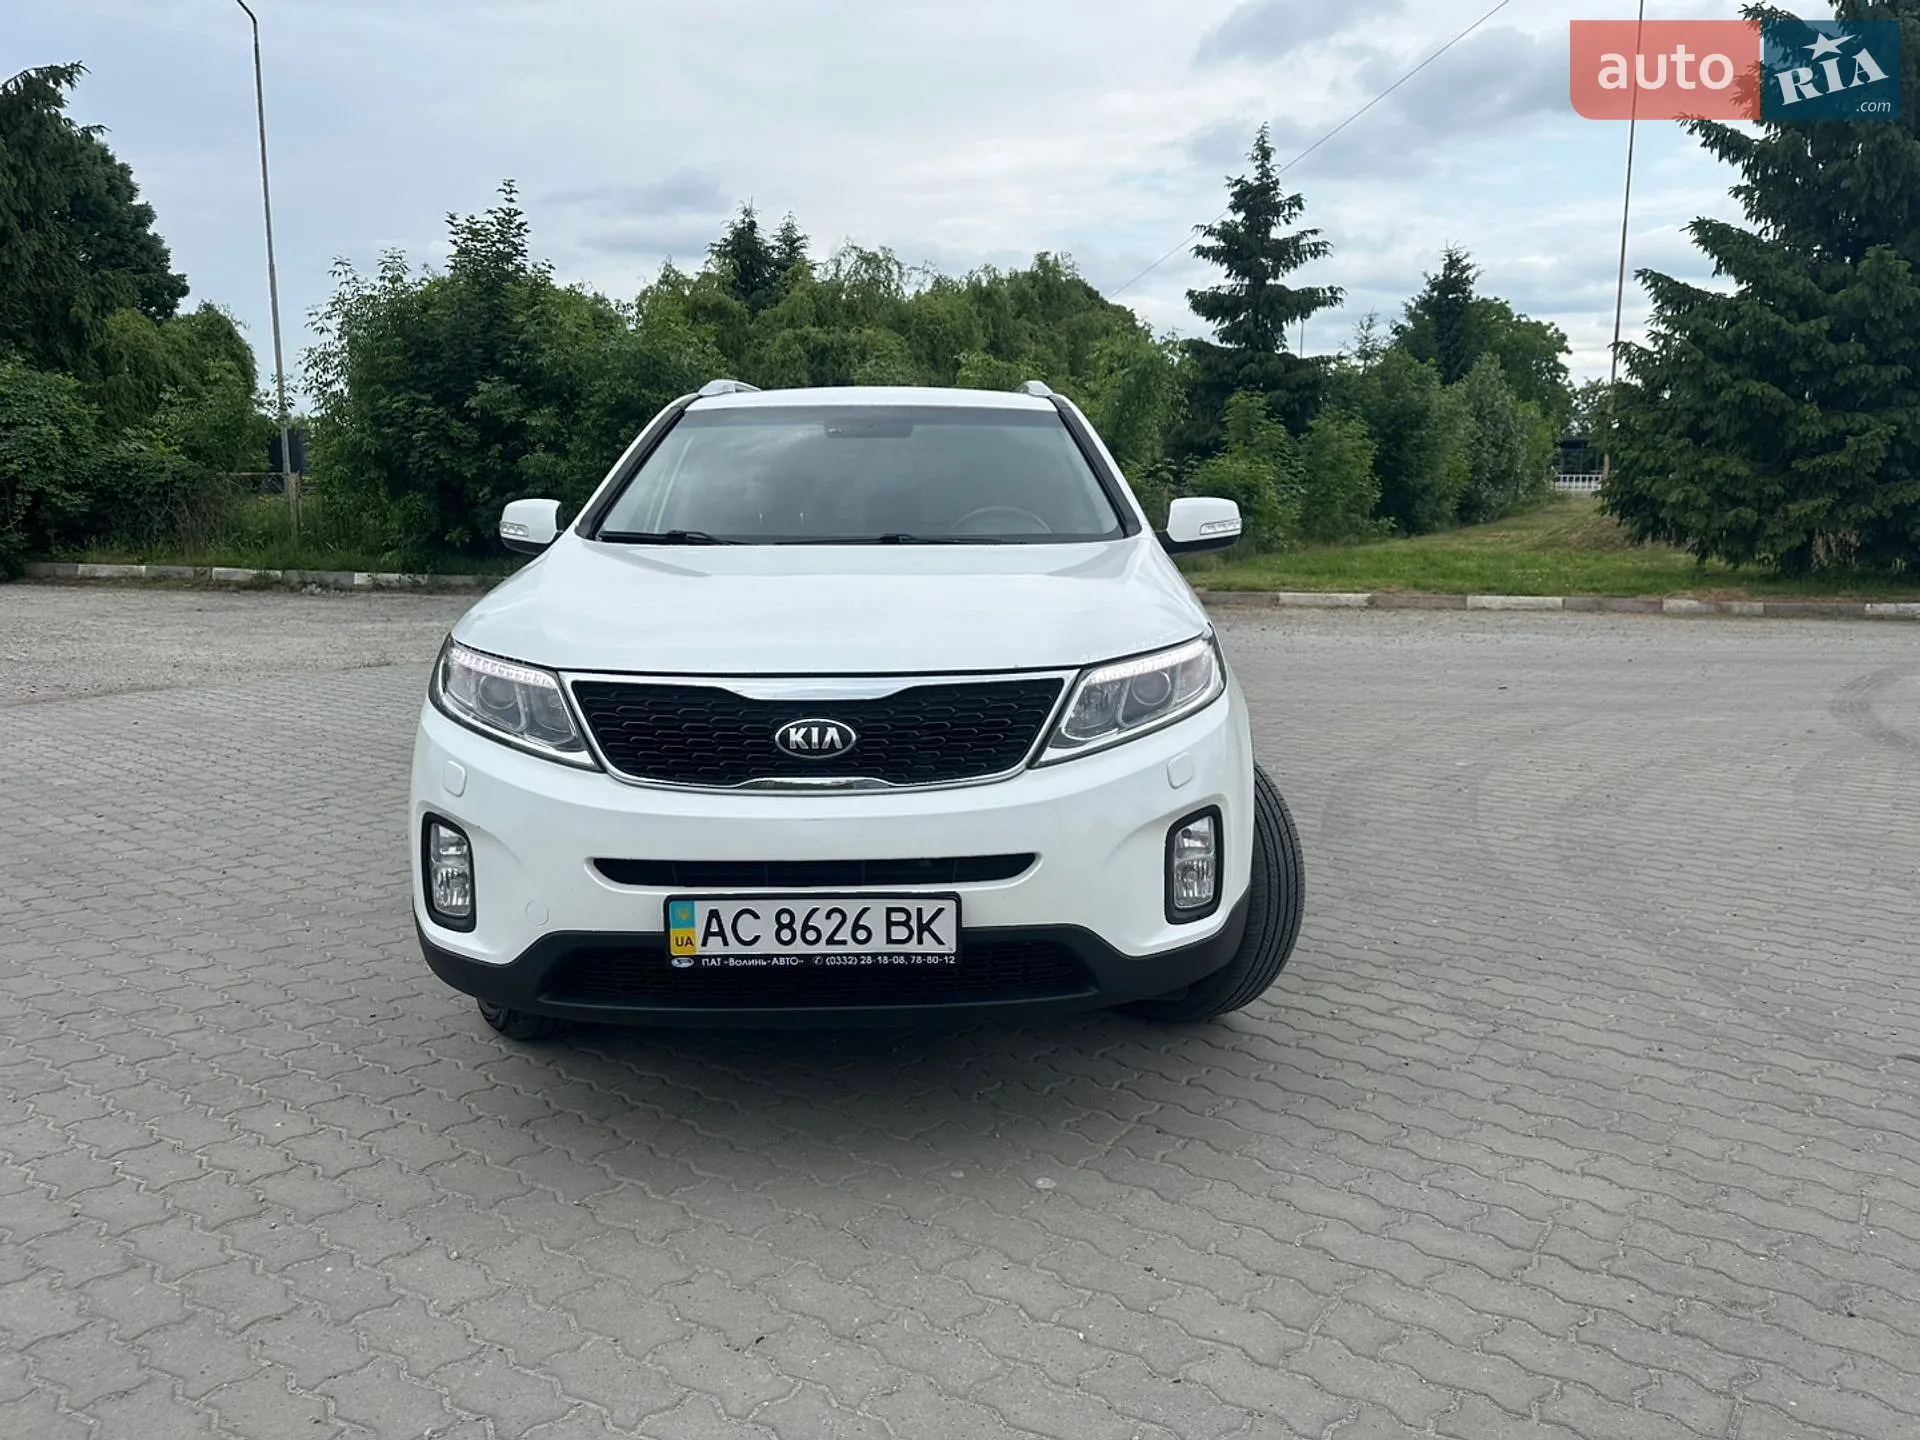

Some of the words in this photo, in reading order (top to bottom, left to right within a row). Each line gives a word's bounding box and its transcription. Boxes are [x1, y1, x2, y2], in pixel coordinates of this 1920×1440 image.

[788, 726, 843, 750] KIA
[701, 908, 761, 947] AC
[775, 907, 873, 946] 8626
[885, 907, 946, 945] BK
[675, 936, 694, 948] UA
